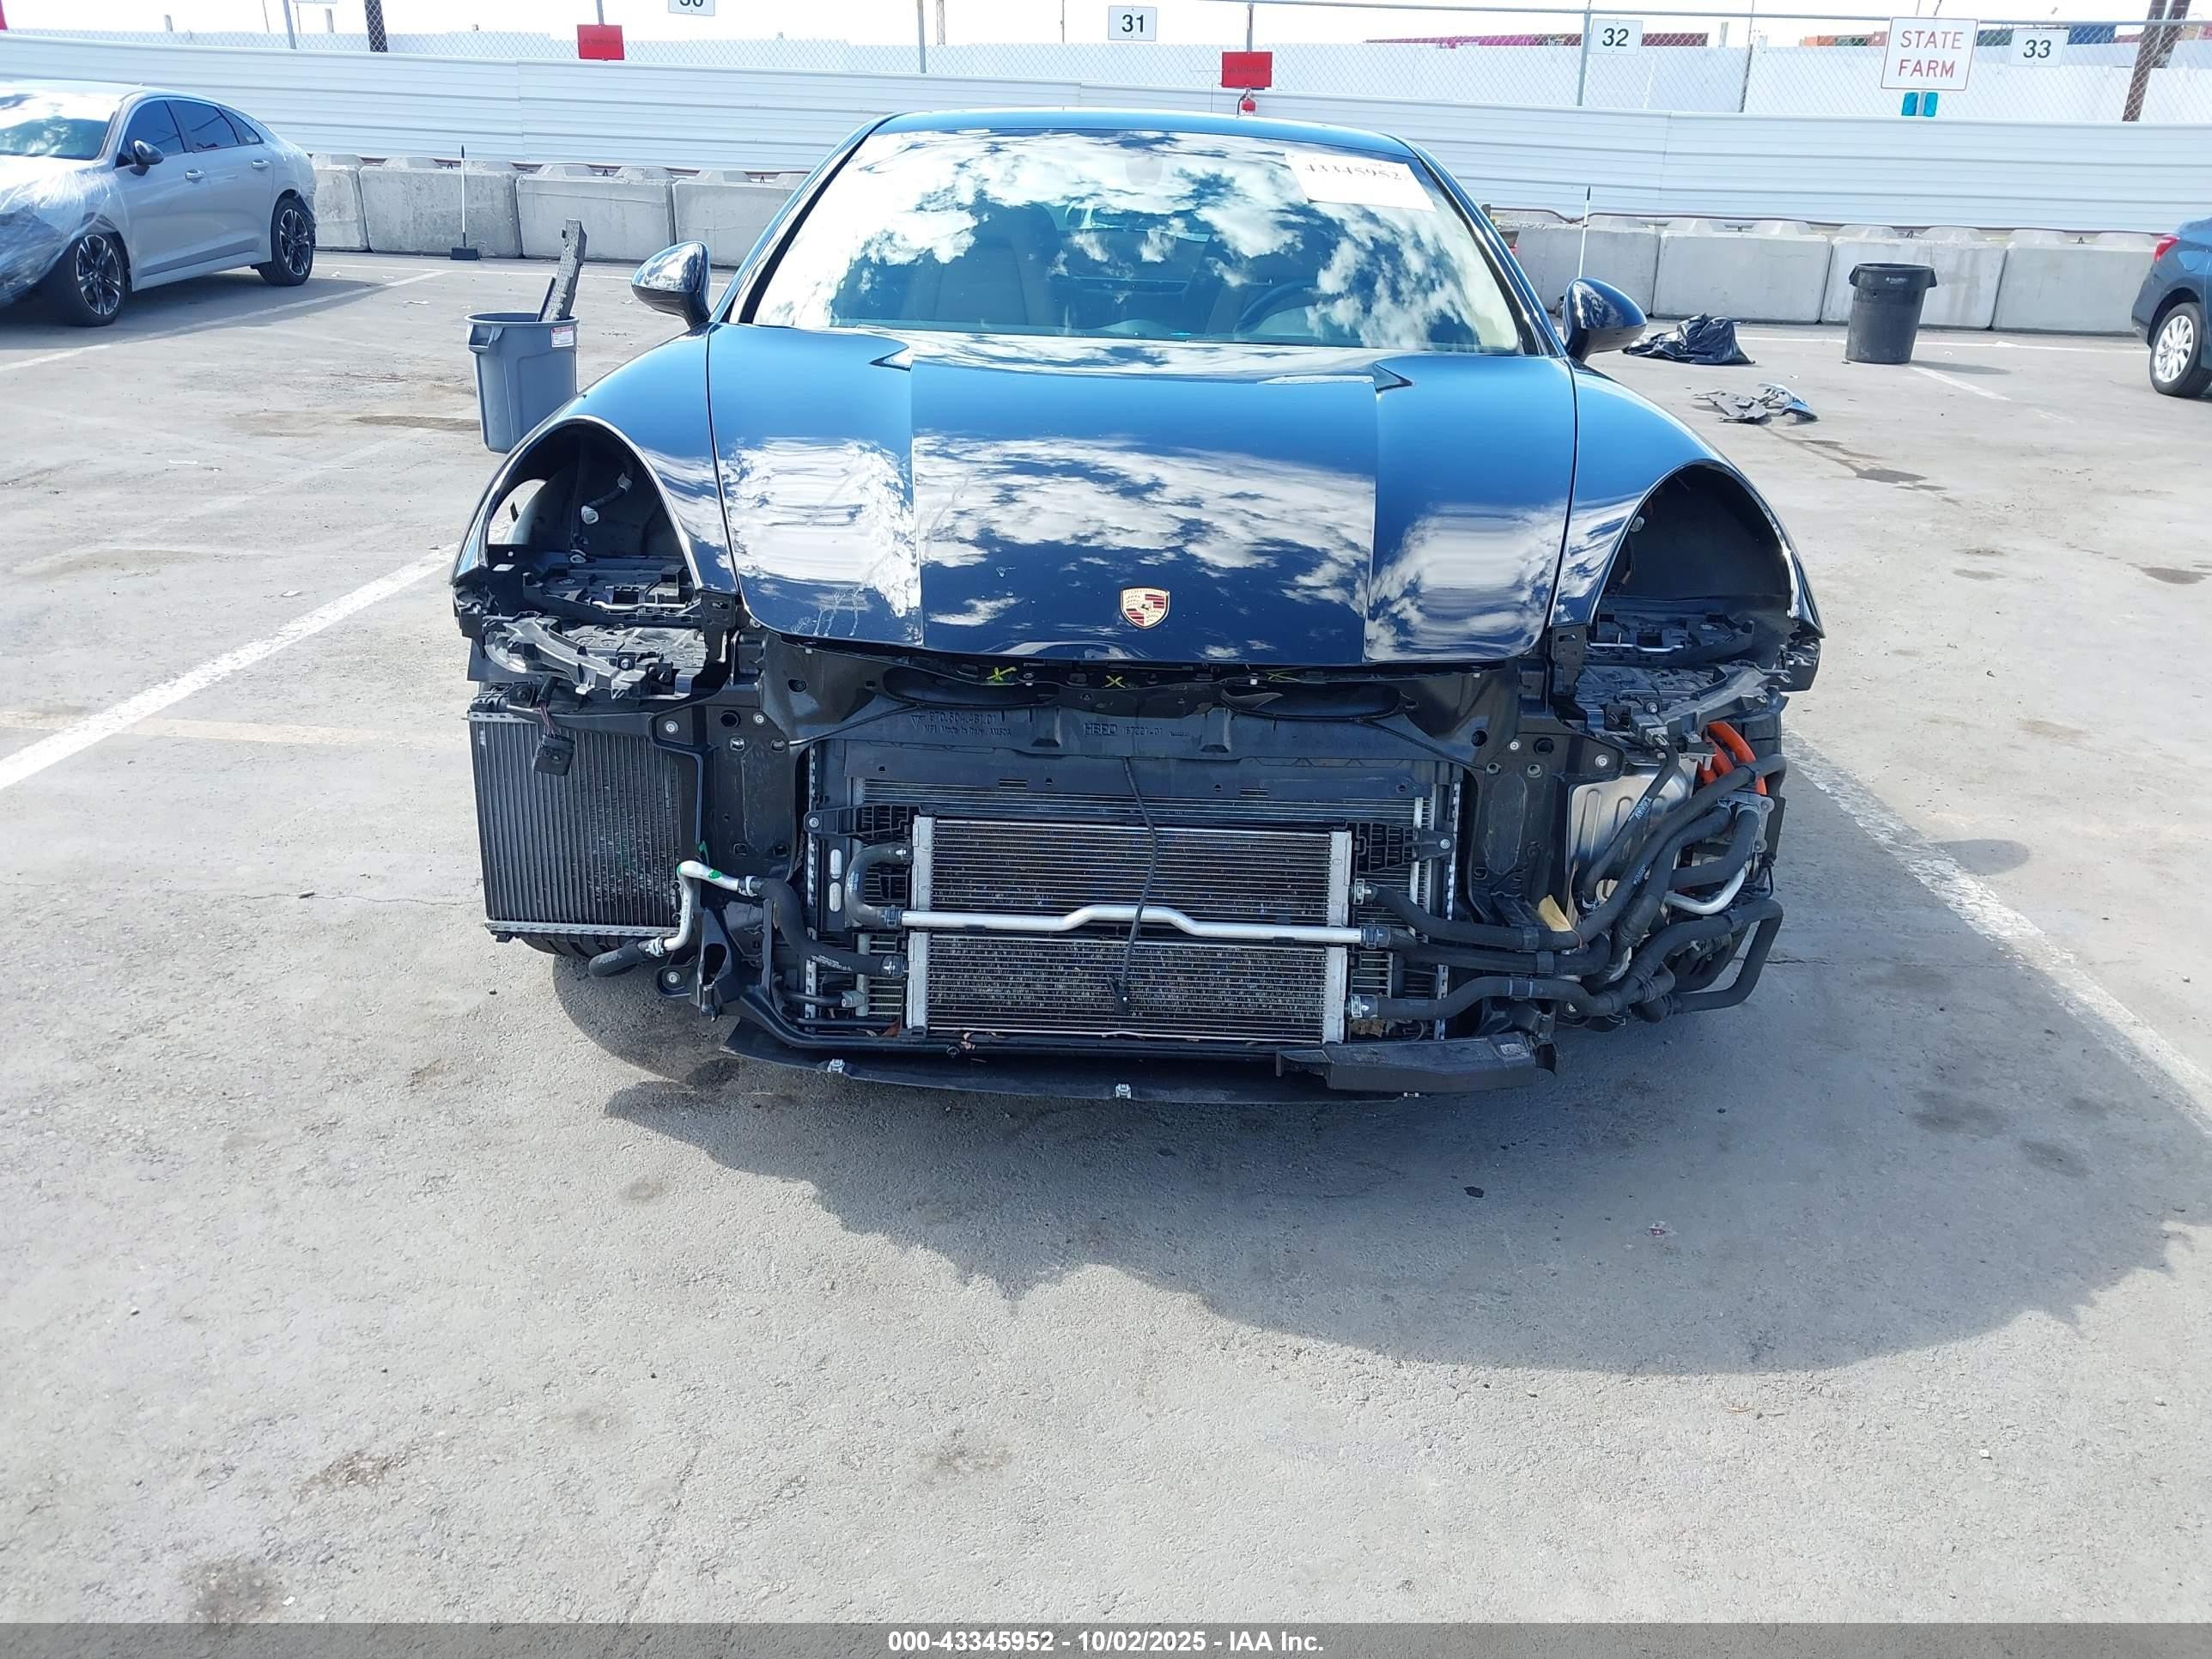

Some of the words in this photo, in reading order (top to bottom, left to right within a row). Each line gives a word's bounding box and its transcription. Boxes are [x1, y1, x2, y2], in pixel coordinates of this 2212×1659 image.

[1121, 14, 1145, 33] 31
[1601, 27, 1630, 47] 32
[1899, 30, 1964, 50] STATE
[2022, 39, 2051, 58] 33
[1898, 58, 1956, 78] FARM
